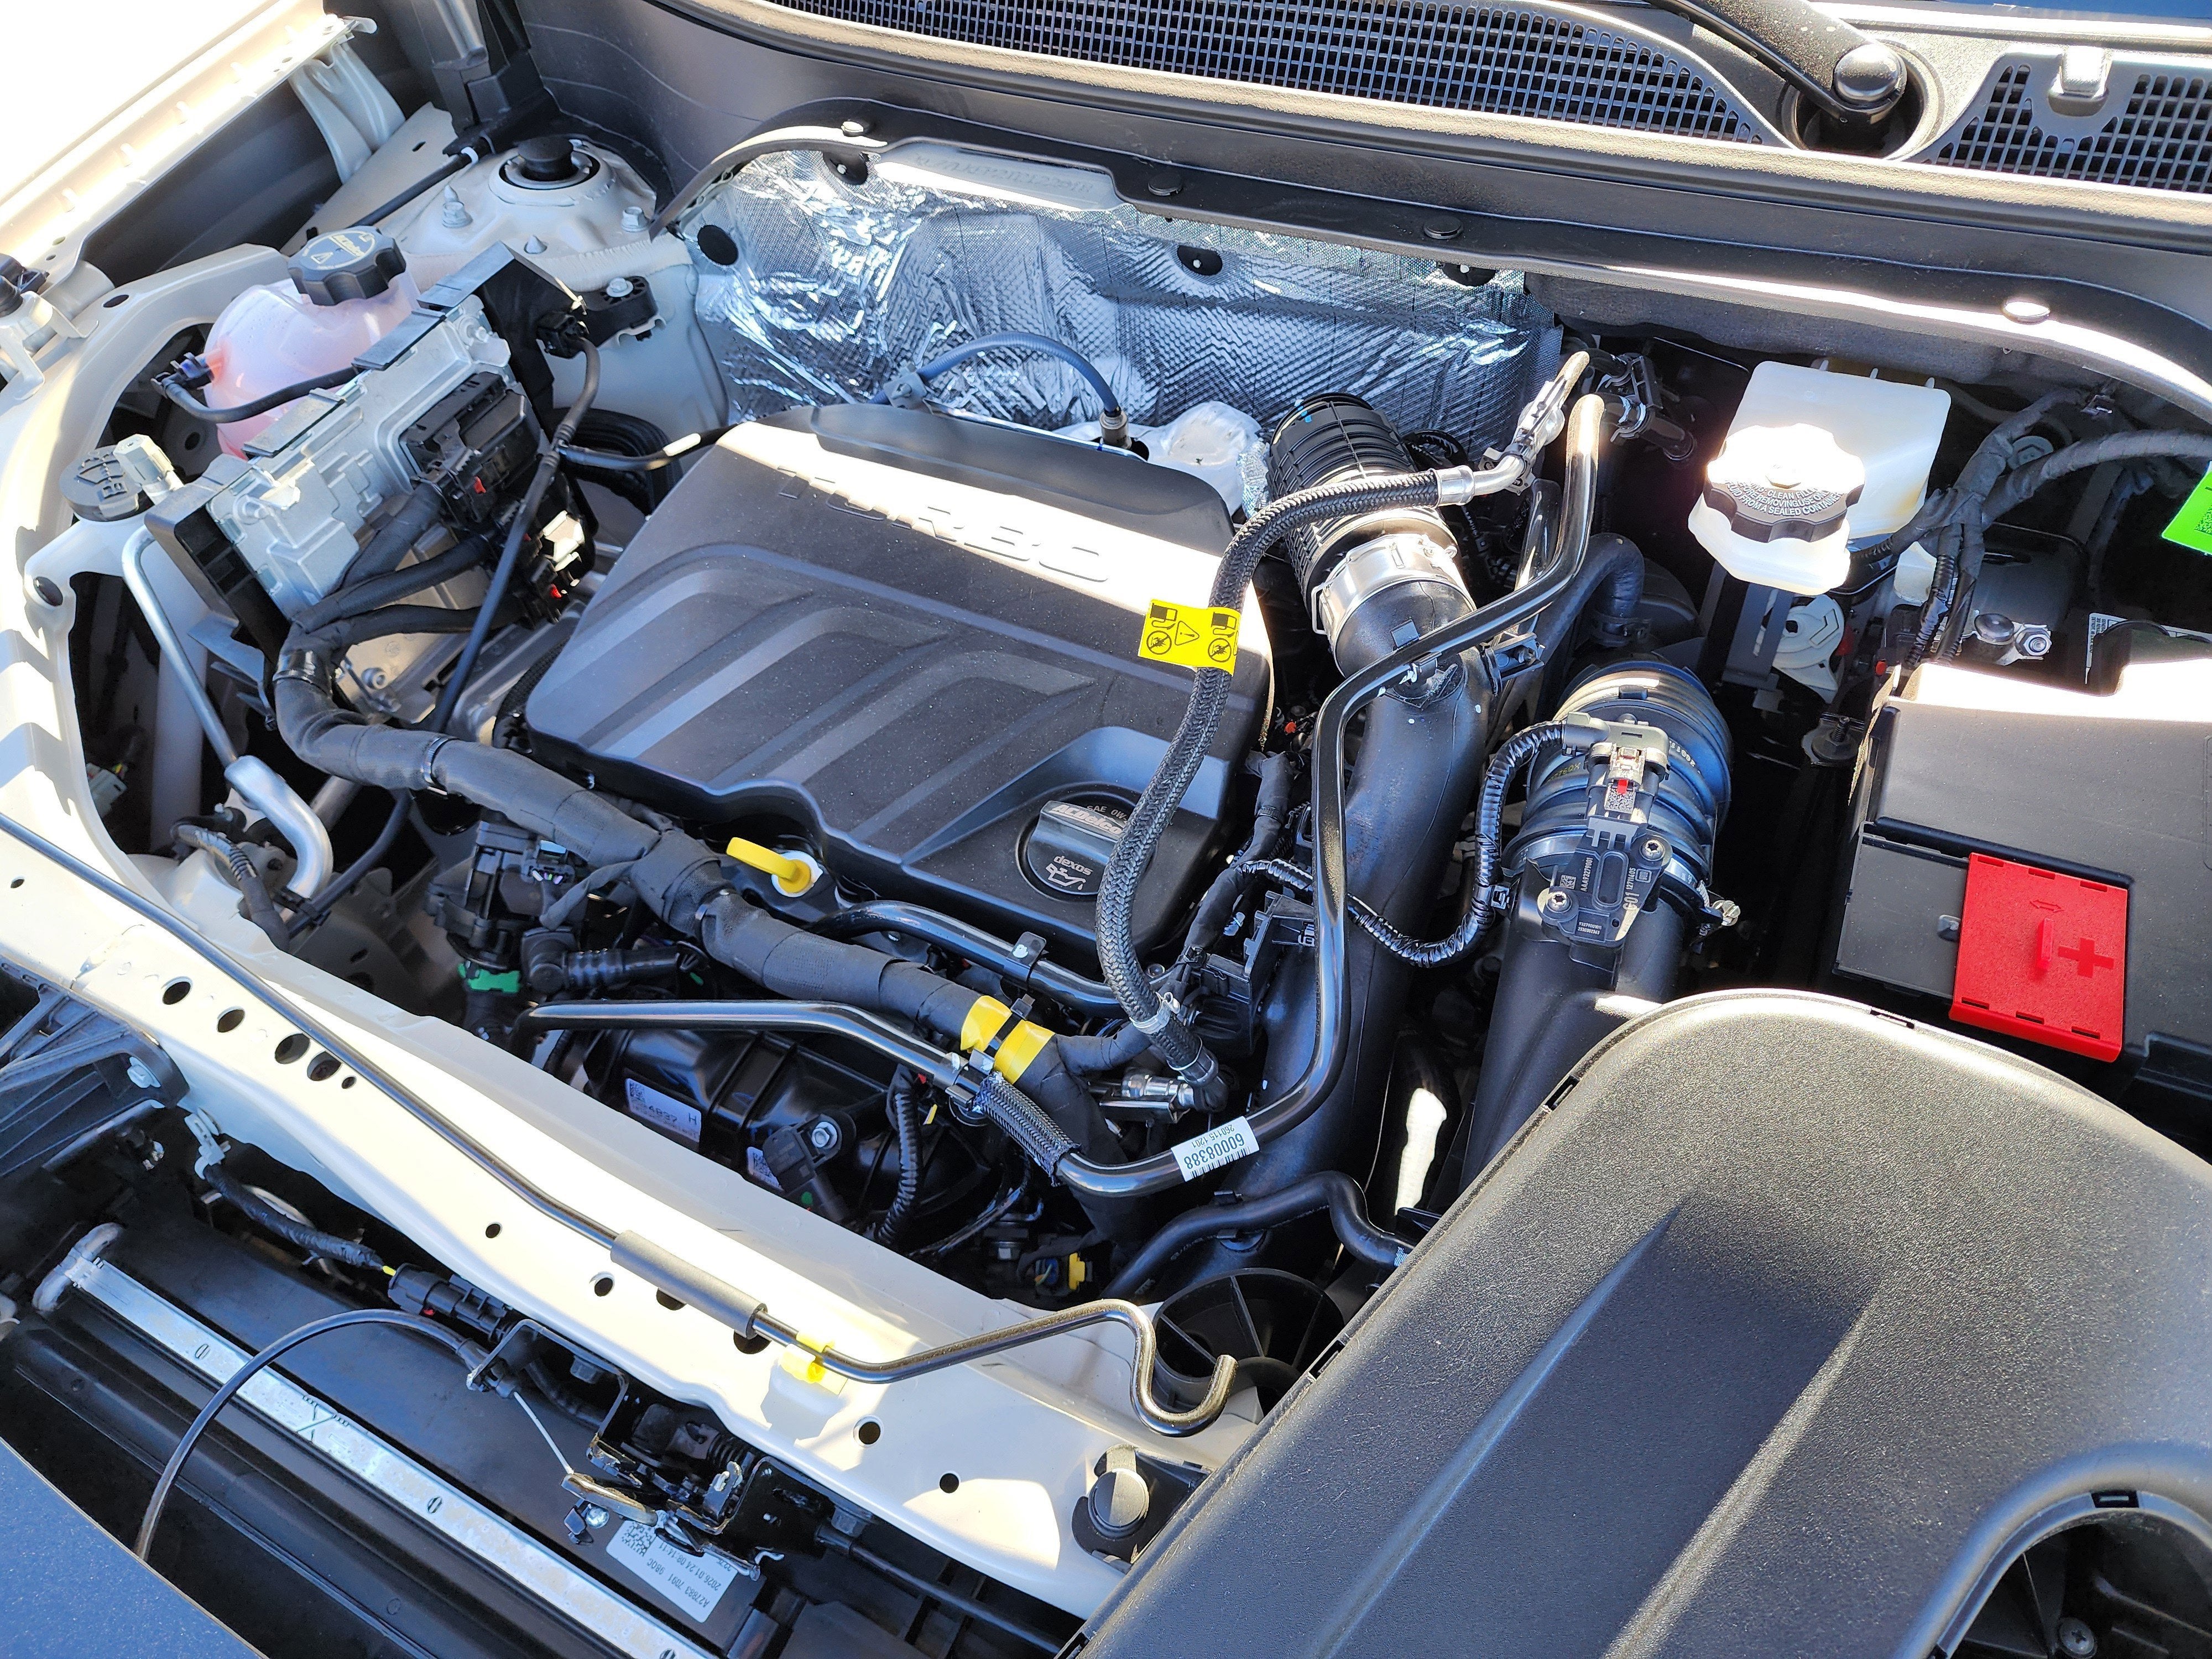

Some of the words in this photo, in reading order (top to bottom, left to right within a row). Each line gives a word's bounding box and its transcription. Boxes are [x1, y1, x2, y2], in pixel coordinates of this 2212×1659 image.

[1738, 495, 1763, 510] FROM
[1760, 504, 1768, 513] A
[1768, 506, 1802, 516] SEALED
[1802, 492, 1843, 515] CONTAINER
[1767, 489, 1795, 499] CLEAN
[1798, 497, 1815, 507] USE
[1051, 804, 1123, 834] ACDelco
[1110, 809, 1128, 824] 0W-
[1053, 855, 1093, 875] dexos
[1580, 857, 1593, 892] AAA93279001
[1626, 867, 1636, 890] 12711405
[1191, 1136, 1208, 1149] 1201
[1209, 1124, 1235, 1141] 260115
[1183, 1133, 1245, 1170] 60008388
